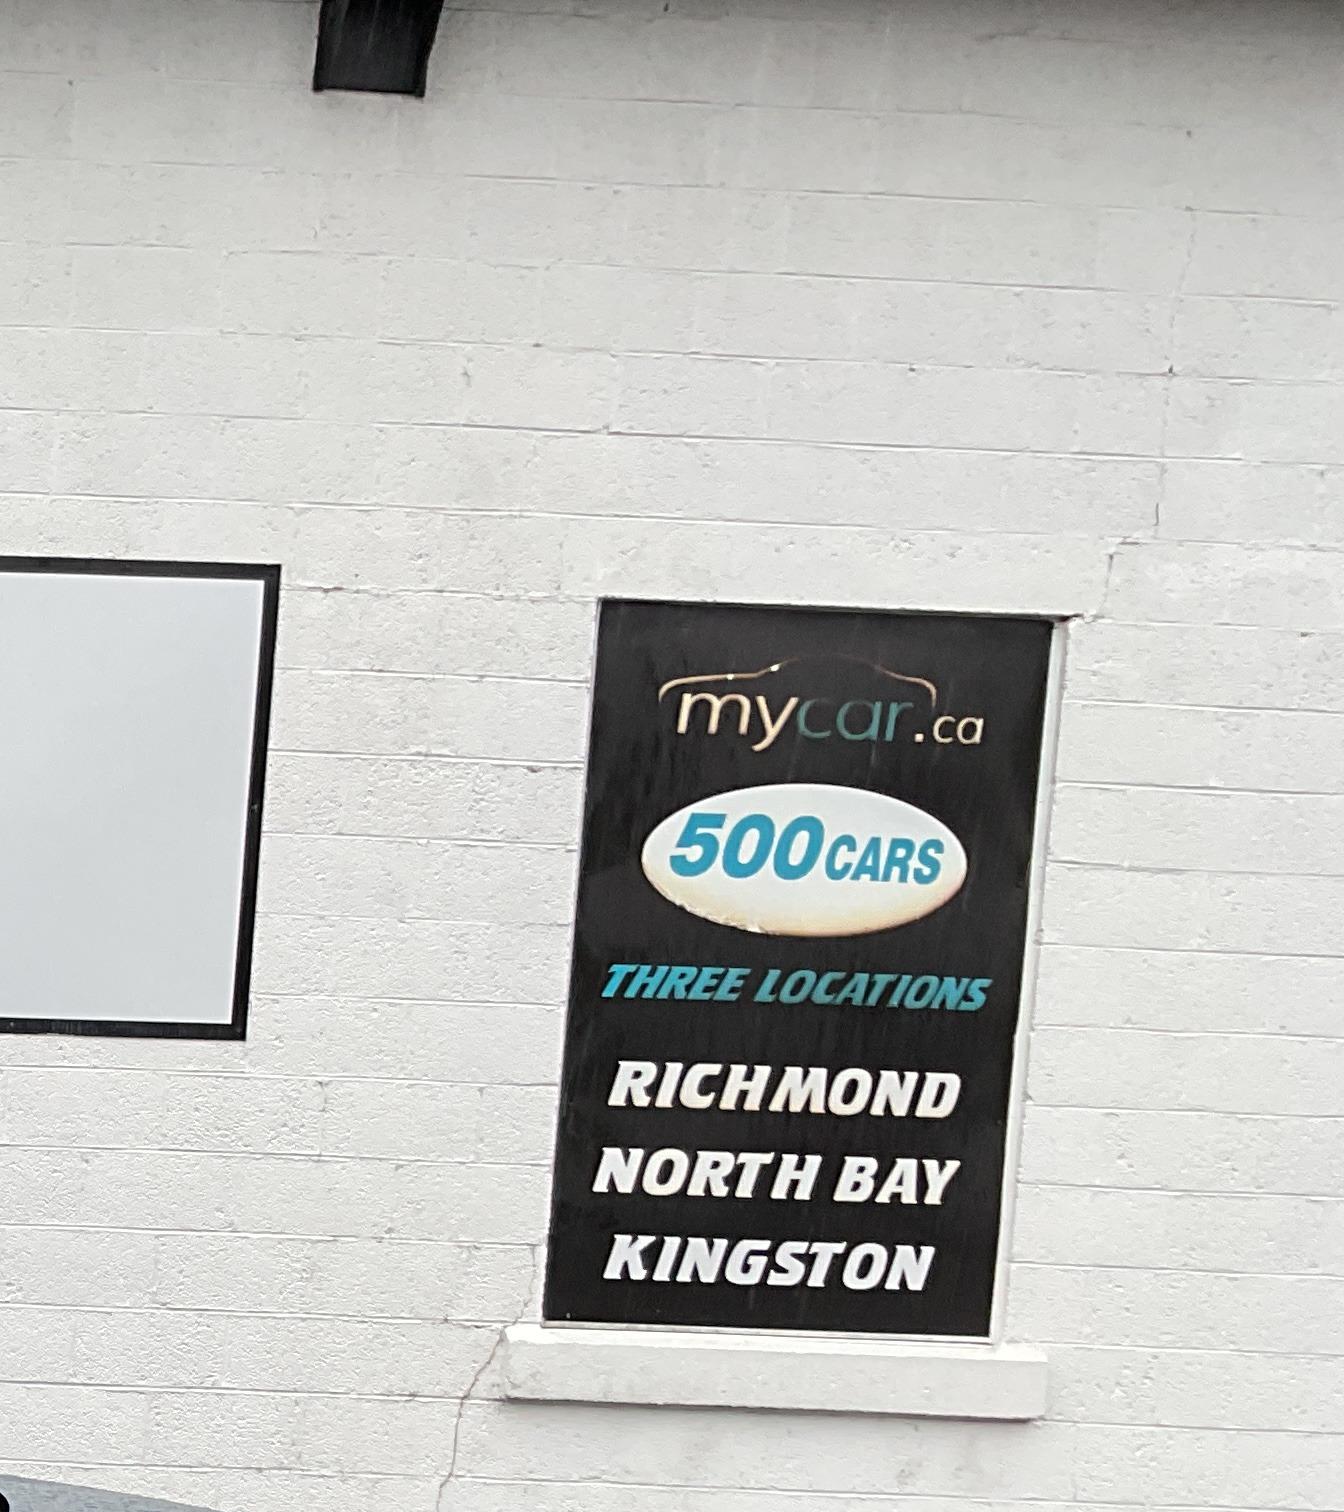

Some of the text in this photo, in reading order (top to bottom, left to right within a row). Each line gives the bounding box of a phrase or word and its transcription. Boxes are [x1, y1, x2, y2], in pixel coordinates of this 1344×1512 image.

[675, 688, 983, 751] mycar.ca
[669, 812, 945, 885] 500 CARS
[600, 963, 992, 1013] THREE LOCATIONS
[607, 1061, 962, 1119] RICHMOND
[592, 1147, 961, 1205] NORTH BAY
[603, 1235, 935, 1292] KINGSTON
